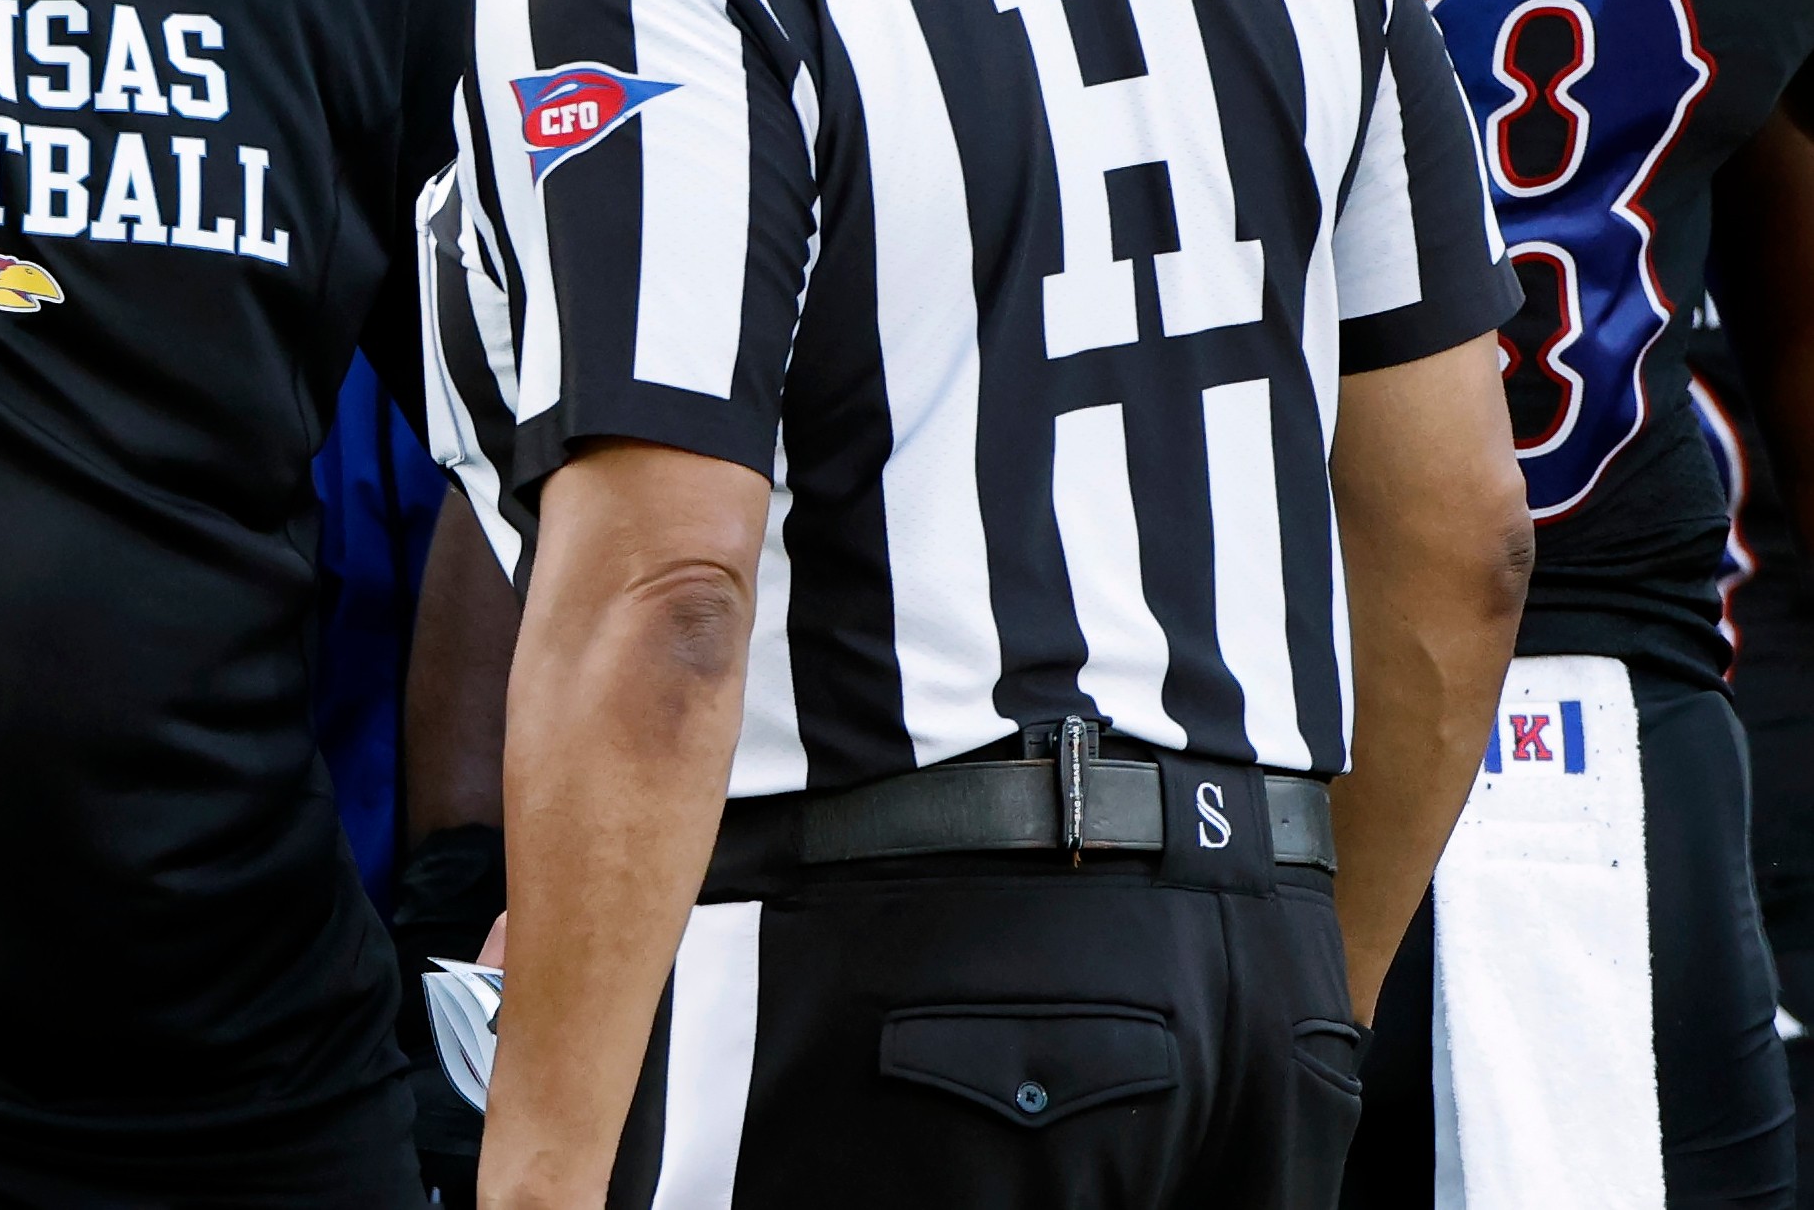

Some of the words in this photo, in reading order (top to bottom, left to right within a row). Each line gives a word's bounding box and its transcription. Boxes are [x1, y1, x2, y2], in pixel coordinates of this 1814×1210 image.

[539, 100, 610, 137] CFO
[1508, 713, 1554, 762] K
[1195, 781, 1233, 850] S
